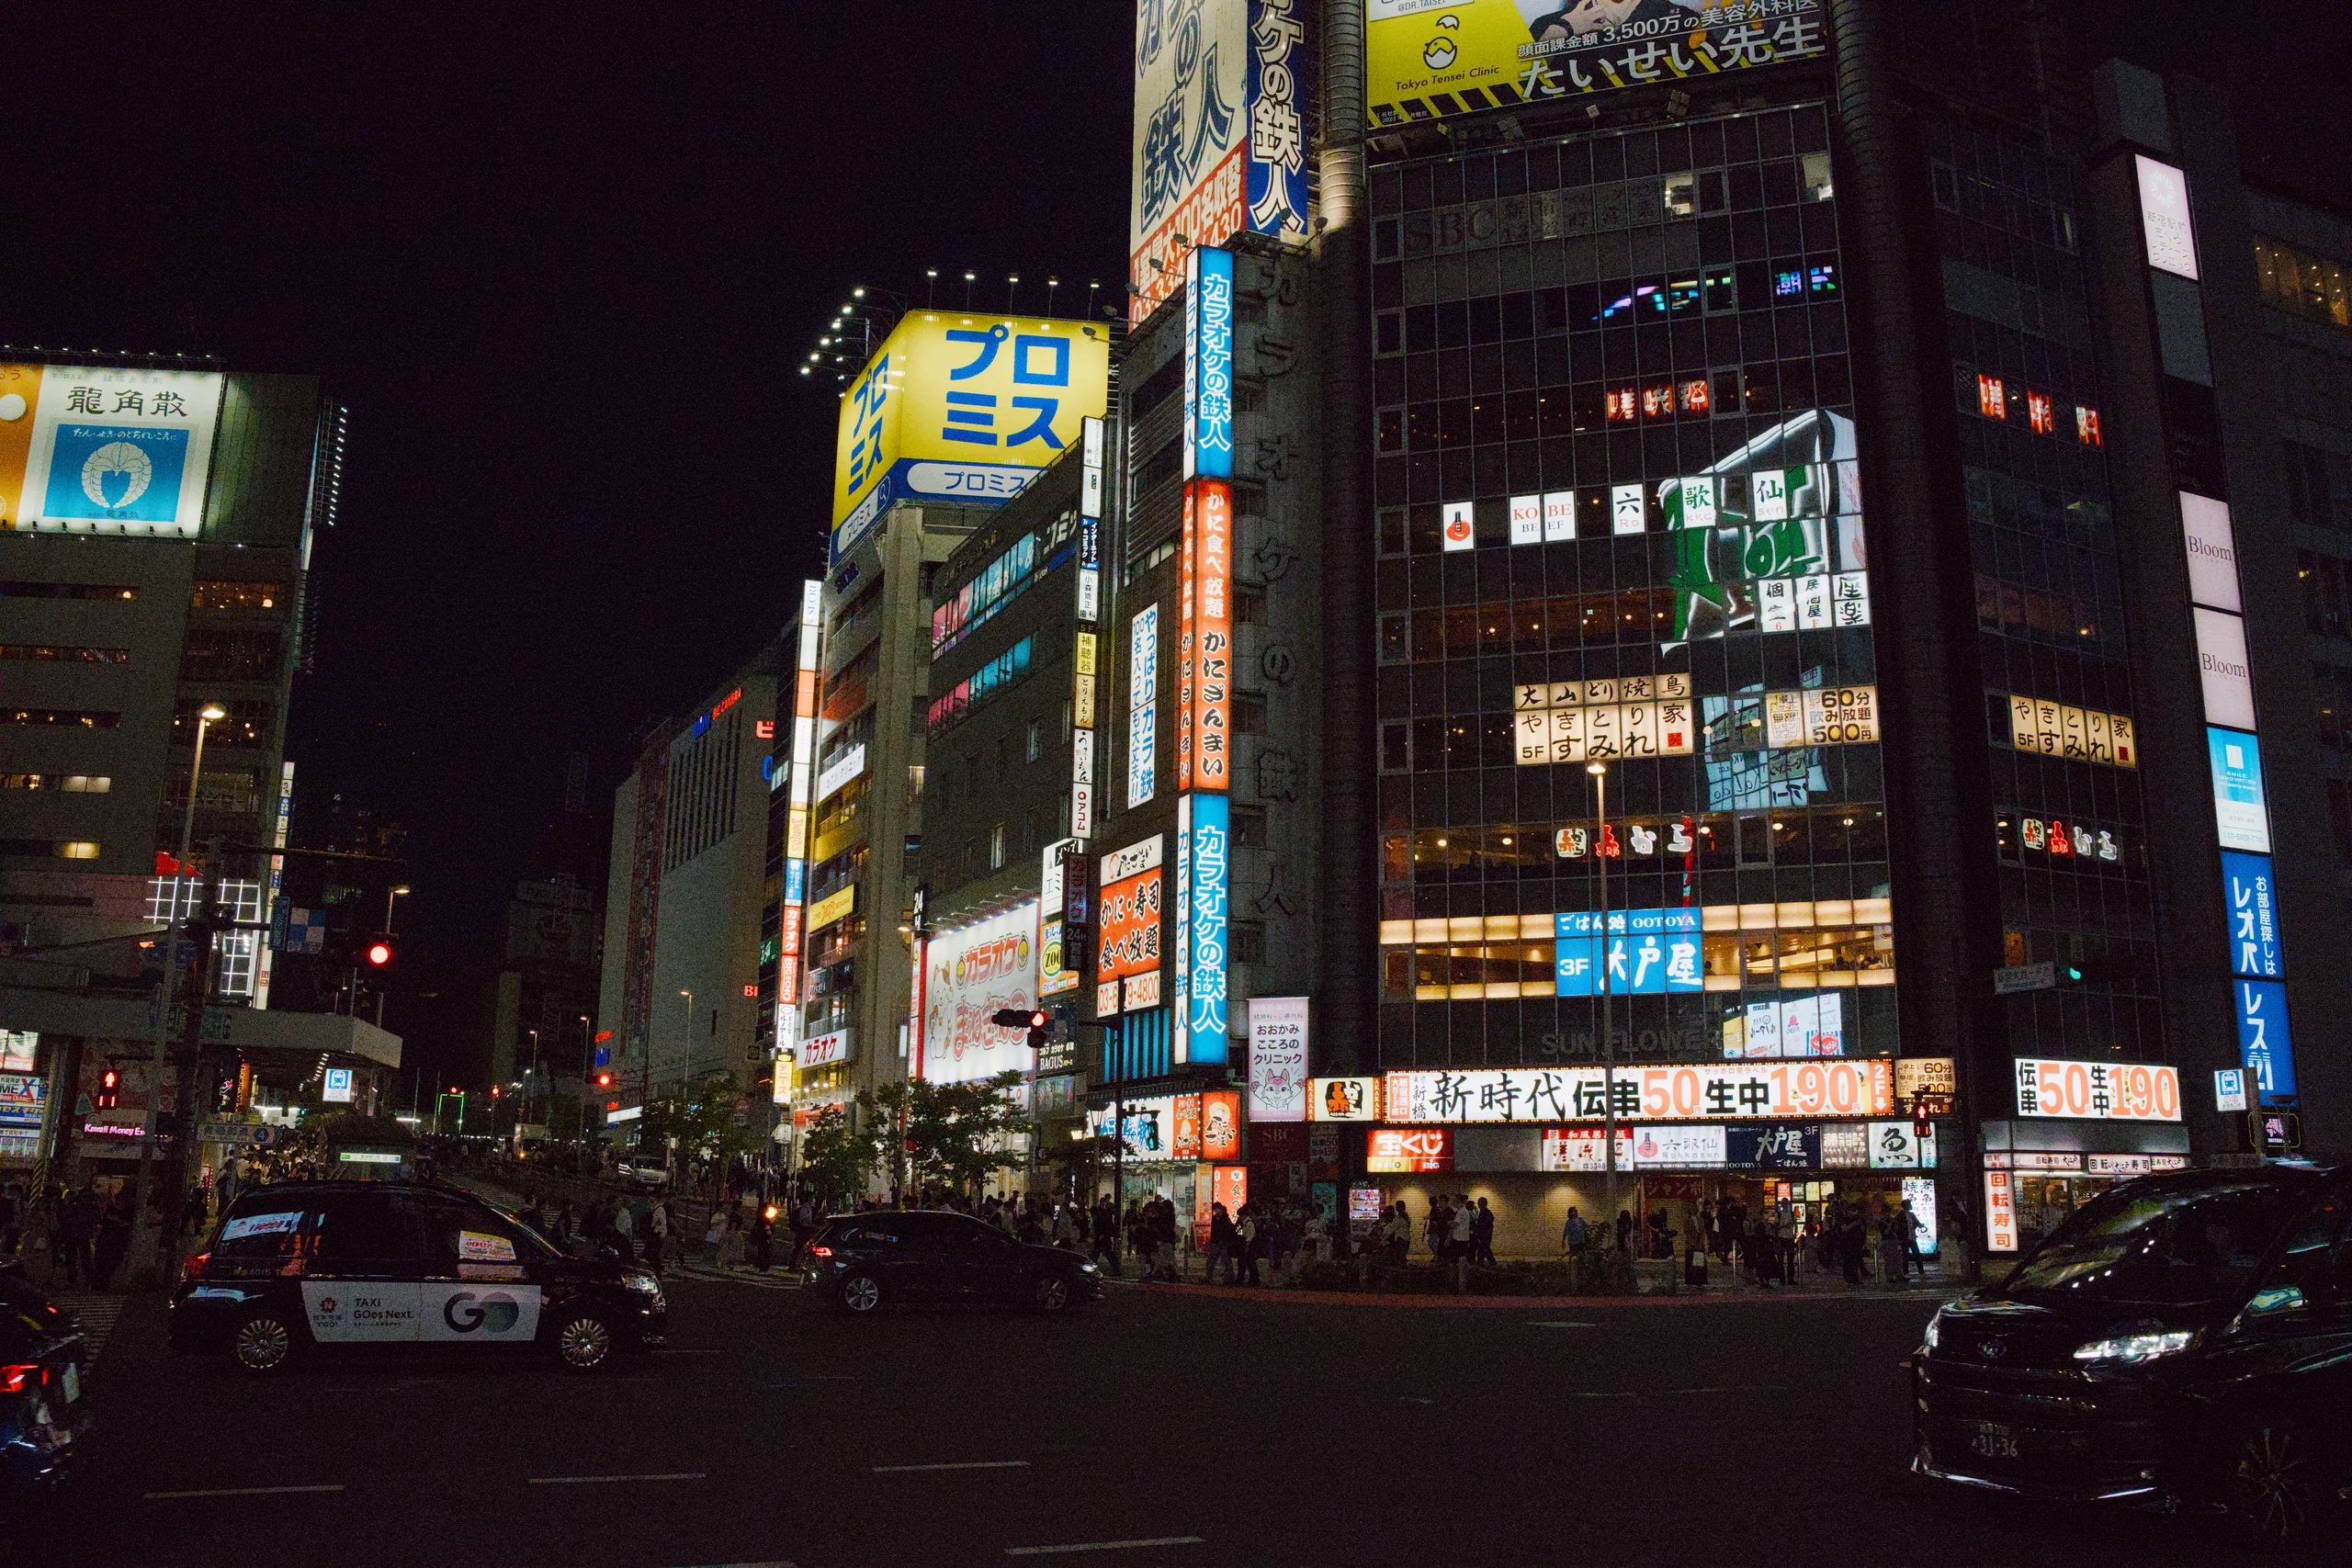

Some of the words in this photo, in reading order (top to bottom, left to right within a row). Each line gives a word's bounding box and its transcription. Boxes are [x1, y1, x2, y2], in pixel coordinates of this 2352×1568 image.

[1518, 31, 1598, 57] 顔面課金額
[1520, 16, 1826, 98] たいせい先生
[1396, 79, 1428, 91] Tokyo
[1432, 70, 1465, 85] Tensei
[1470, 65, 1499, 78] Clinic
[946, 324, 1069, 387] プロ
[1184, 279, 1196, 452] カラオケの鉄人
[1199, 274, 1231, 451] カラオケの鉄人
[66, 386, 187, 417] 龍角散
[942, 390, 1065, 449] ミス
[944, 471, 1025, 493] プロミス
[1204, 492, 1225, 618] かに食べ放題
[2188, 536, 2232, 561] Bloom
[1080, 635, 1092, 671] 補聴器
[2201, 652, 2245, 678] Bloom
[1140, 610, 1157, 798] やっぱりカラ鉄
[1519, 675, 1685, 708] 大山どり焼鳥
[1822, 690, 1871, 708] 60分
[1521, 704, 1687, 733] やきとり家
[1810, 709, 1871, 724] 飲み放題
[2015, 702, 2130, 739] やきとり家
[1522, 746, 1544, 759] 5F
[1553, 731, 1655, 761] すみれ
[2018, 734, 2034, 746] 5F
[2040, 730, 2110, 762] すみれ
[1078, 803, 1087, 830] アコム
[792, 818, 804, 852] Denny's
[1102, 879, 1160, 927] かに・寿司
[786, 909, 797, 952] カラオケ
[1176, 829, 1189, 1030] カラオケの鉄人
[1192, 826, 1227, 1033] カラオケの鉄人
[1633, 916, 1696, 929] OOTOYA
[2233, 876, 2258, 974] レオパ
[2256, 876, 2276, 975] お部屋探しは
[966, 934, 1018, 986] カラオケ
[1101, 923, 1159, 972] 食べ放題
[1559, 959, 1589, 976] 3F
[1600, 936, 1702, 990] 大戸屋
[1257, 1023, 1300, 1035] おおかみ
[1257, 1039, 1300, 1050] こころの
[1542, 1032, 1596, 1055] SUN
[805, 1035, 838, 1065] カラオケ
[1039, 1054, 1064, 1071] BAGUS
[1253, 1054, 1303, 1065] クリニック
[778, 1064, 787, 1095] デニーズ
[1917, 1074, 1952, 1082] 飲み放題
[1925, 1062, 1951, 1073] 60分
[1412, 1085, 1427, 1120] 新橋
[1429, 1071, 1576, 1122] 新時代
[1573, 1079, 1641, 1118] 伝串
[1705, 1077, 1770, 1115] 生中
[2018, 1062, 2038, 1114] 伝串
[2091, 1066, 2109, 1116] 生中
[1904, 1103, 1941, 1114] すれ
[1376, 1133, 1443, 1156] 宝くじ
[1568, 1131, 1625, 1139] 和風居屋
[1662, 1138, 1718, 1151] 六歌仙
[1756, 1125, 1807, 1162] 大戸屋
[1805, 1126, 1818, 1135] 3F
[1879, 1126, 1914, 1164] 魚
[1991, 1173, 2011, 1248] 回転寿司
[354, 1310, 383, 1319] GOes
